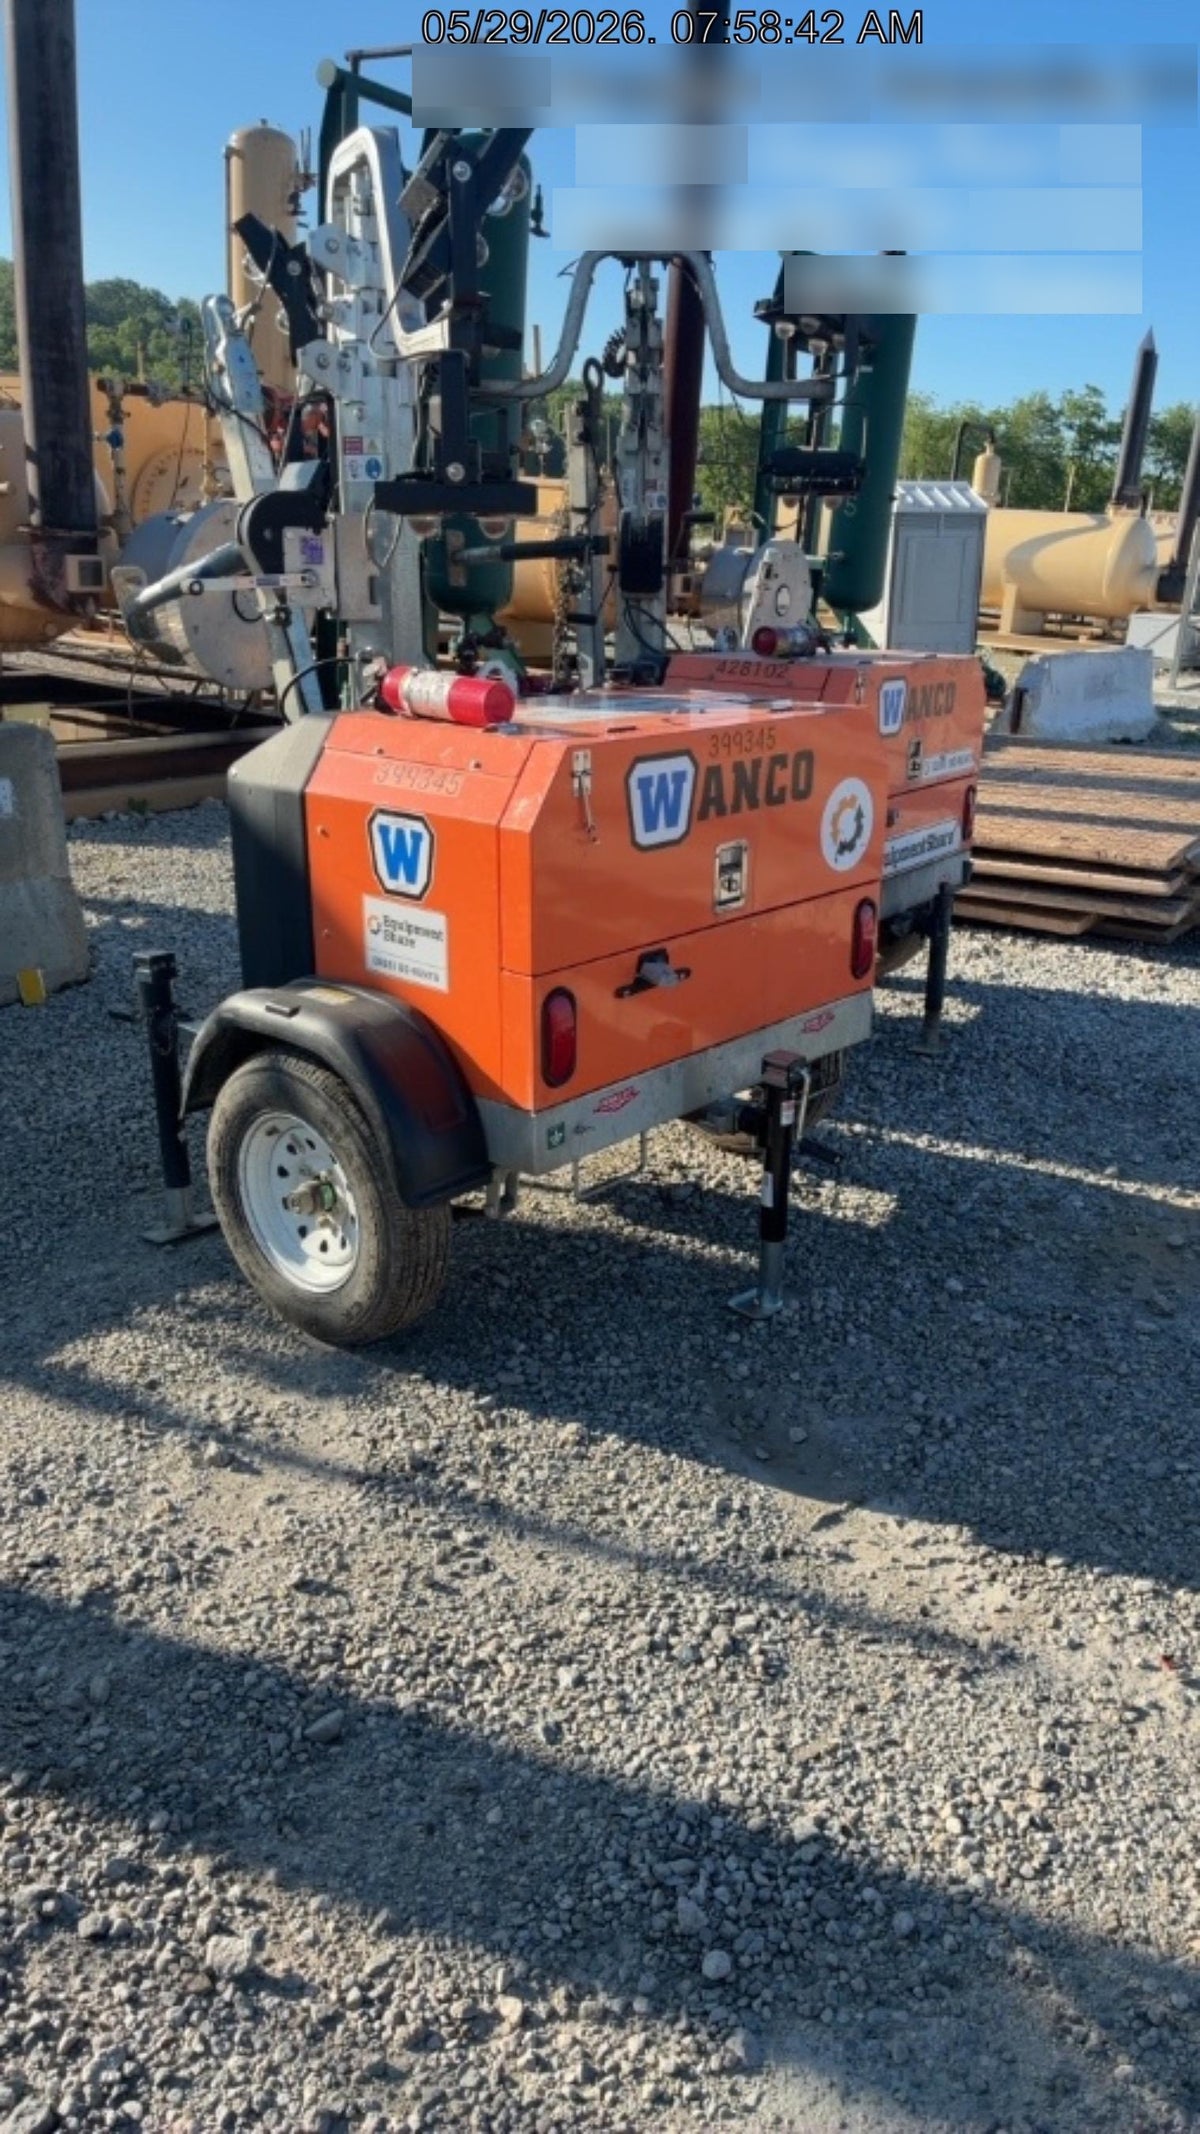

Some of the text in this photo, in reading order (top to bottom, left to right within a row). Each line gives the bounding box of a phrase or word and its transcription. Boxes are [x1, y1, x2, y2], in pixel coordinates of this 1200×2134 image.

[716, 660, 790, 679] 428102
[884, 682, 956, 726] WANCO
[709, 727, 776, 757] 399345
[377, 764, 462, 795] 399345
[637, 749, 815, 833] WANCO
[378, 823, 423, 885] W
